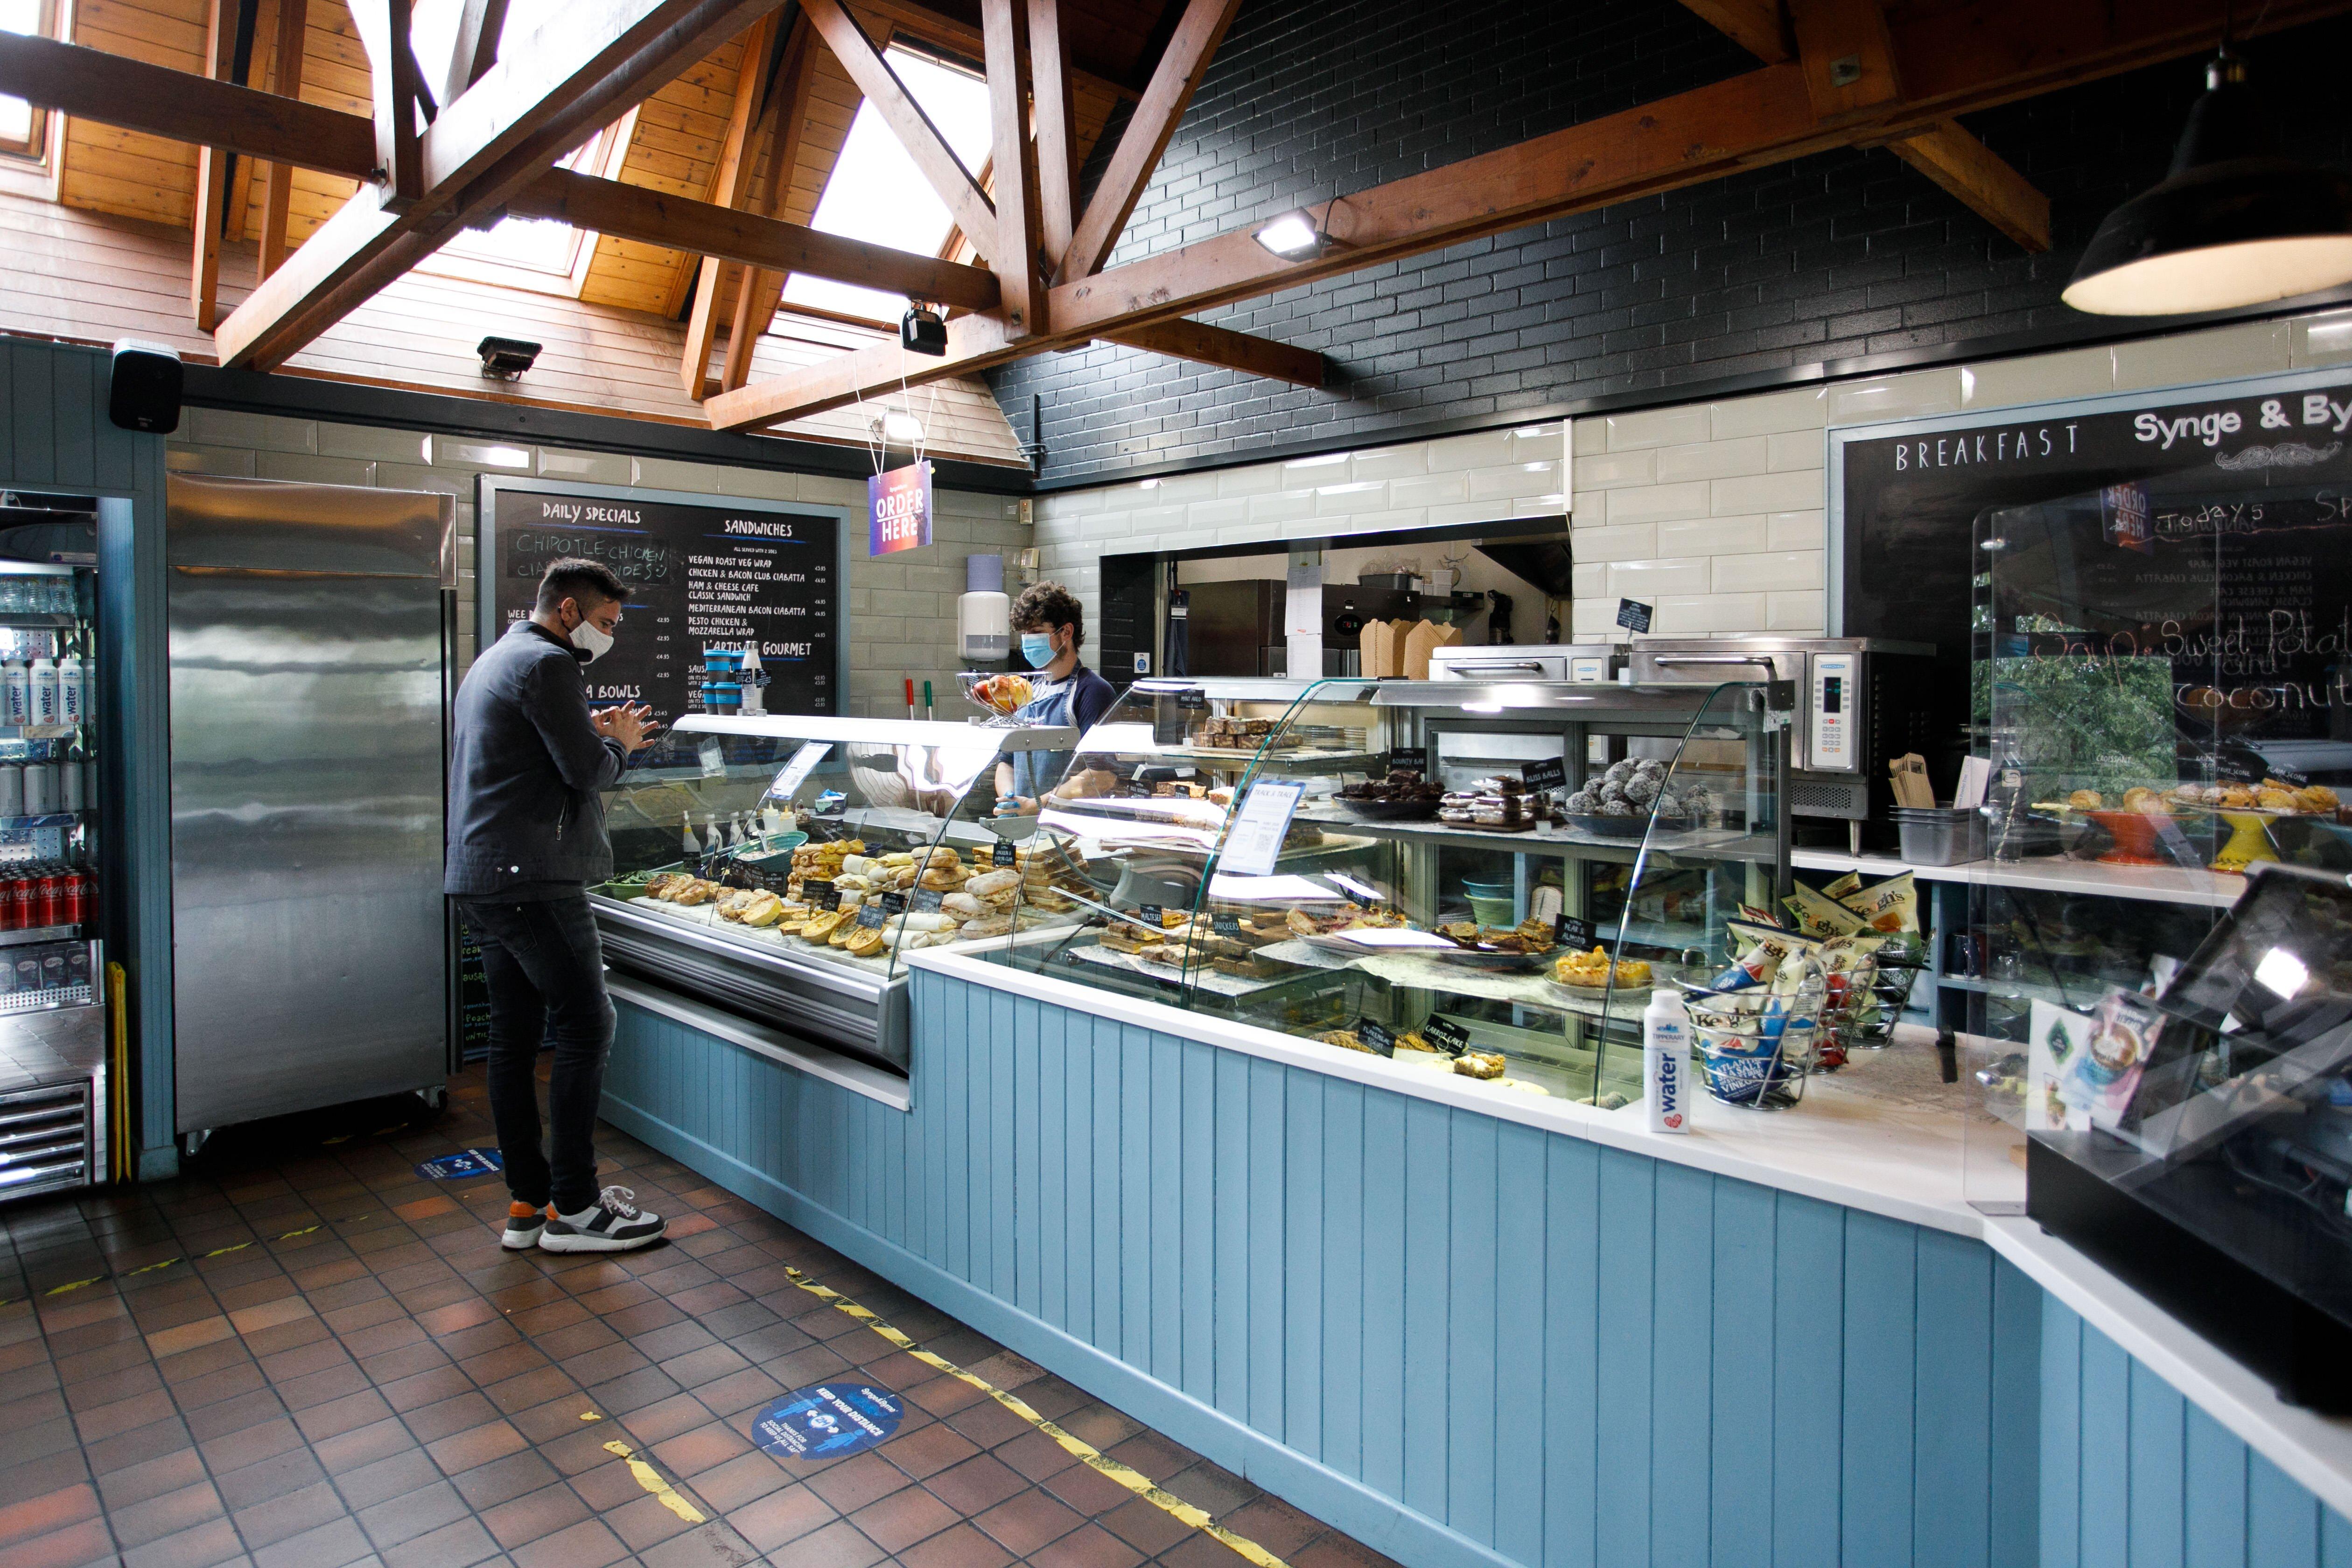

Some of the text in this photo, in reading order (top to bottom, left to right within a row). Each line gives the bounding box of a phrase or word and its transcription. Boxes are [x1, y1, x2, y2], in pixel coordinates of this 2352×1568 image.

[2135, 411, 2241, 450] Synge
[2261, 400, 2290, 428] &
[1896, 425, 2078, 471] BREAKFAST
[876, 488, 924, 518] ORDER
[543, 502, 641, 524] DAILY SPECIALS
[725, 519, 792, 537] SANDWICHES
[882, 514, 918, 542] HERE
[516, 534, 665, 563] CHIPOTLE CHICKEN
[688, 555, 772, 568] VEGAN ROAST VEG WRAP
[688, 568, 805, 582] CHICKEN & BACON CLUB CIABATTA
[688, 581, 759, 592] HAM & CHEESE CAFE
[688, 591, 751, 602] CLASSIC SANDWICH
[508, 609, 526, 619] WEE
[688, 603, 806, 616] MEDITERRANEAN BACON CIABATTA
[688, 617, 748, 627] PESTO CHICKEN &
[688, 627, 755, 637] MOZZARELLA WRAP
[2161, 617, 2250, 657] Sweet
[763, 641, 812, 656] GOURMET
[598, 684, 641, 699] BOWLS
[11, 686, 23, 716] water
[40, 686, 52, 716] water
[65, 685, 77, 715] water
[1526, 769, 1561, 784] BLISS BALLS
[1141, 913, 1162, 922] MALTESER
[1213, 921, 1239, 931] SNICKERS
[1564, 923, 1578, 933] PEAR
[1561, 932, 1586, 945] ALMOND
[1425, 1024, 1464, 1049] CARROT CAKE
[1736, 1062, 1762, 1073] SALT
[1658, 1052, 1676, 1113] water
[816, 1386, 884, 1437] KEEP YOUR DISTANCE
[765, 1426, 777, 1436] KEEP
[767, 1420, 807, 1452] SOCIAL DISTANCING
[781, 1422, 807, 1443] THANKS FOR
